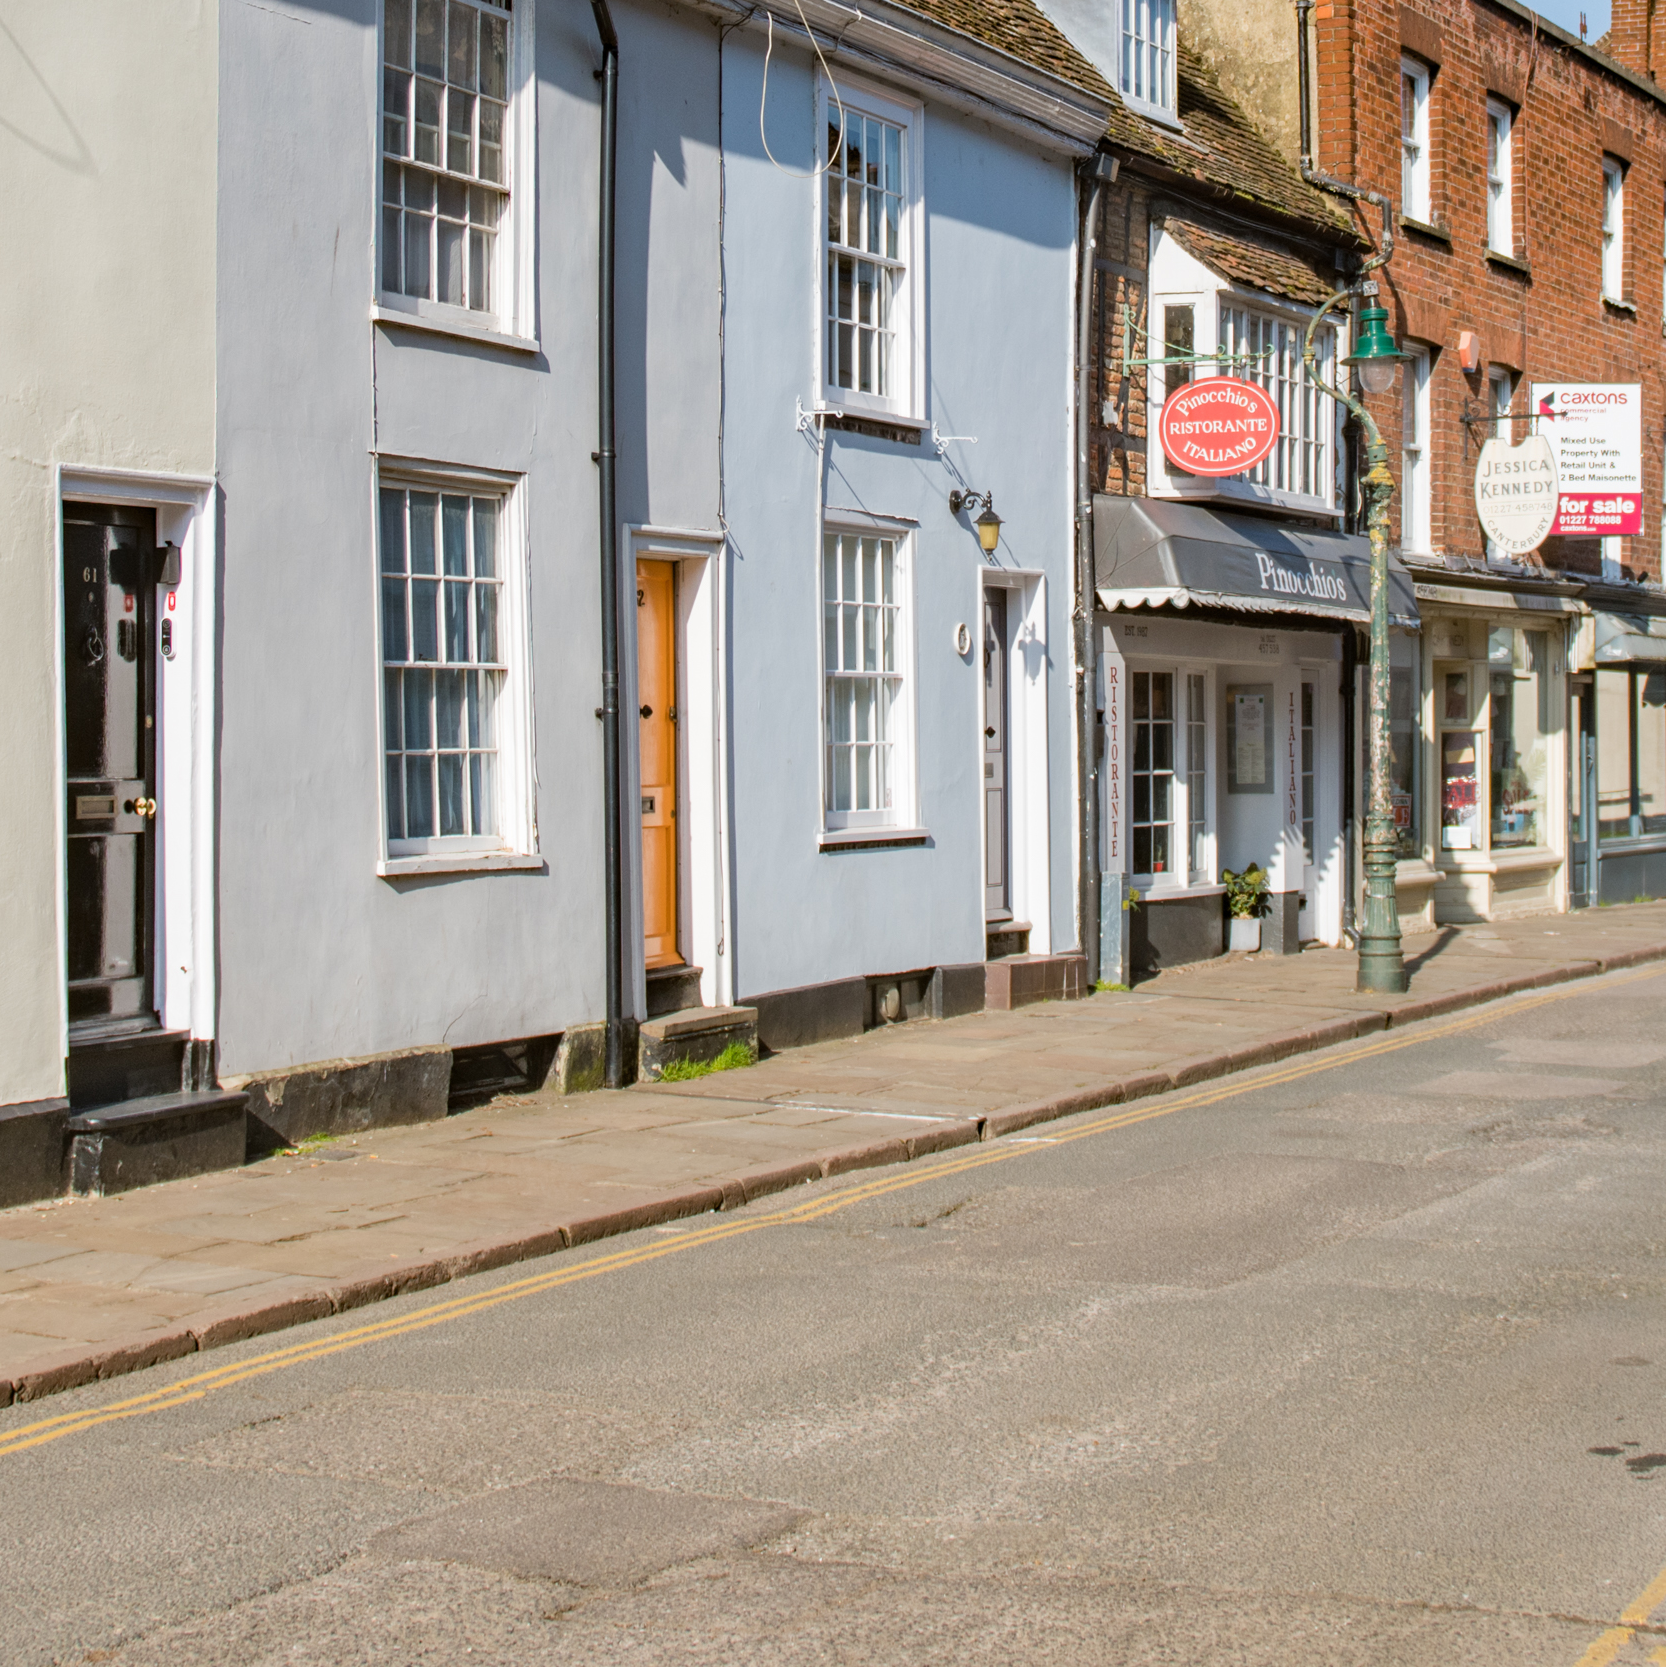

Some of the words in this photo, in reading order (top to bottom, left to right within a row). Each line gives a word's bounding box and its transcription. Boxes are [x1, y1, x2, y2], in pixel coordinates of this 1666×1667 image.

[1175, 387, 1258, 417] Pinocchio's
[1560, 391, 1628, 405] caxtons
[1170, 418, 1268, 435] RISTORANTE
[1183, 437, 1257, 462] ITALIANO
[1561, 449, 1598, 458] Property
[1601, 449, 1621, 457] With
[1482, 459, 1550, 478] JESSICA
[1561, 461, 1586, 469] Retail
[1588, 461, 1607, 469] Unit
[1480, 480, 1553, 500] KENNEDY
[1559, 496, 1589, 514] for
[1592, 496, 1635, 514] sale
[1559, 515, 1587, 525] 01227
[1589, 515, 1622, 525] 788088
[1487, 517, 1549, 550] CANTERBURY
[83, 566, 98, 583] 61
[1255, 552, 1347, 601] Pinocchio's
[637, 589, 646, 607] 2
[1109, 666, 1118, 858] RISTORANTE
[1288, 691, 1296, 826] ITALIANO
